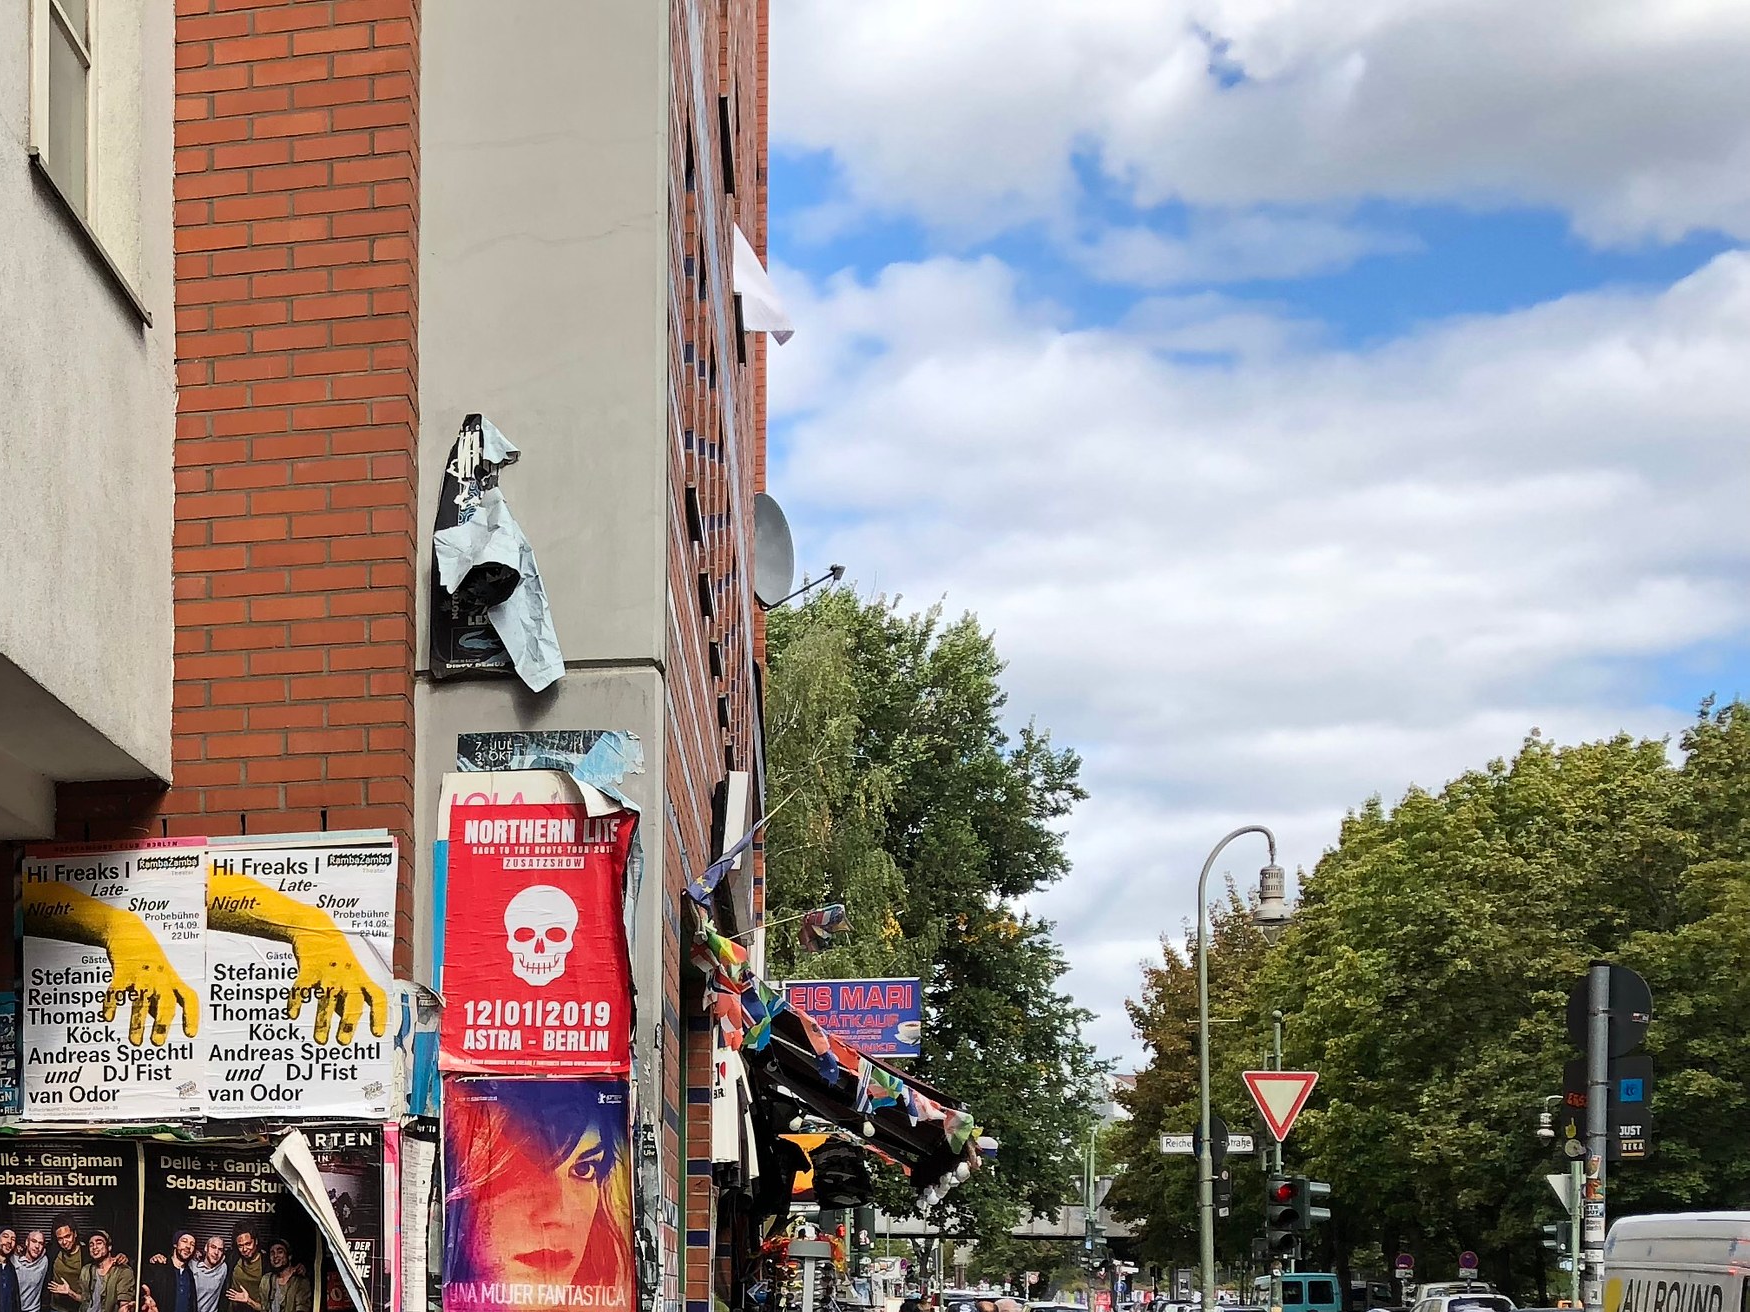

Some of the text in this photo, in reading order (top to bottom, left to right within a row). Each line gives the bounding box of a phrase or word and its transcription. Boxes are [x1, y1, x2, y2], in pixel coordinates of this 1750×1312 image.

[488, 751, 513, 761] OKT
[464, 818, 620, 844] NORTHERN LITE
[506, 858, 582, 867] ZUSATZSHOW
[27, 865, 48, 883] Hi
[55, 862, 119, 882] Freaks
[91, 883, 129, 896] Late-
[27, 898, 170, 917] Night- Show
[145, 912, 199, 921] Probebühne
[175, 922, 199, 930] 14.09.
[171, 931, 199, 940] 22 Uhr
[81, 956, 107, 964] Gäste
[31, 966, 113, 986] Stefanie
[791, 985, 912, 1011] EIS MARI
[28, 1008, 105, 1025] Thomas
[67, 1025, 121, 1044] Köck,
[463, 1029, 608, 1051] ASTRA BERLIN
[28, 1043, 193, 1065] Andreas Spechtl
[44, 1064, 172, 1084] und DJ Fist
[28, 1086, 120, 1103] van Odor
[1619, 1125, 1642, 1136] JUST
[41, 1154, 123, 1170] Ganjaman
[67, 1173, 117, 1186] Sturm
[8, 1192, 94, 1206] Jahcoustix
[451, 1282, 626, 1307] UNA MUJER FANTASTICA
